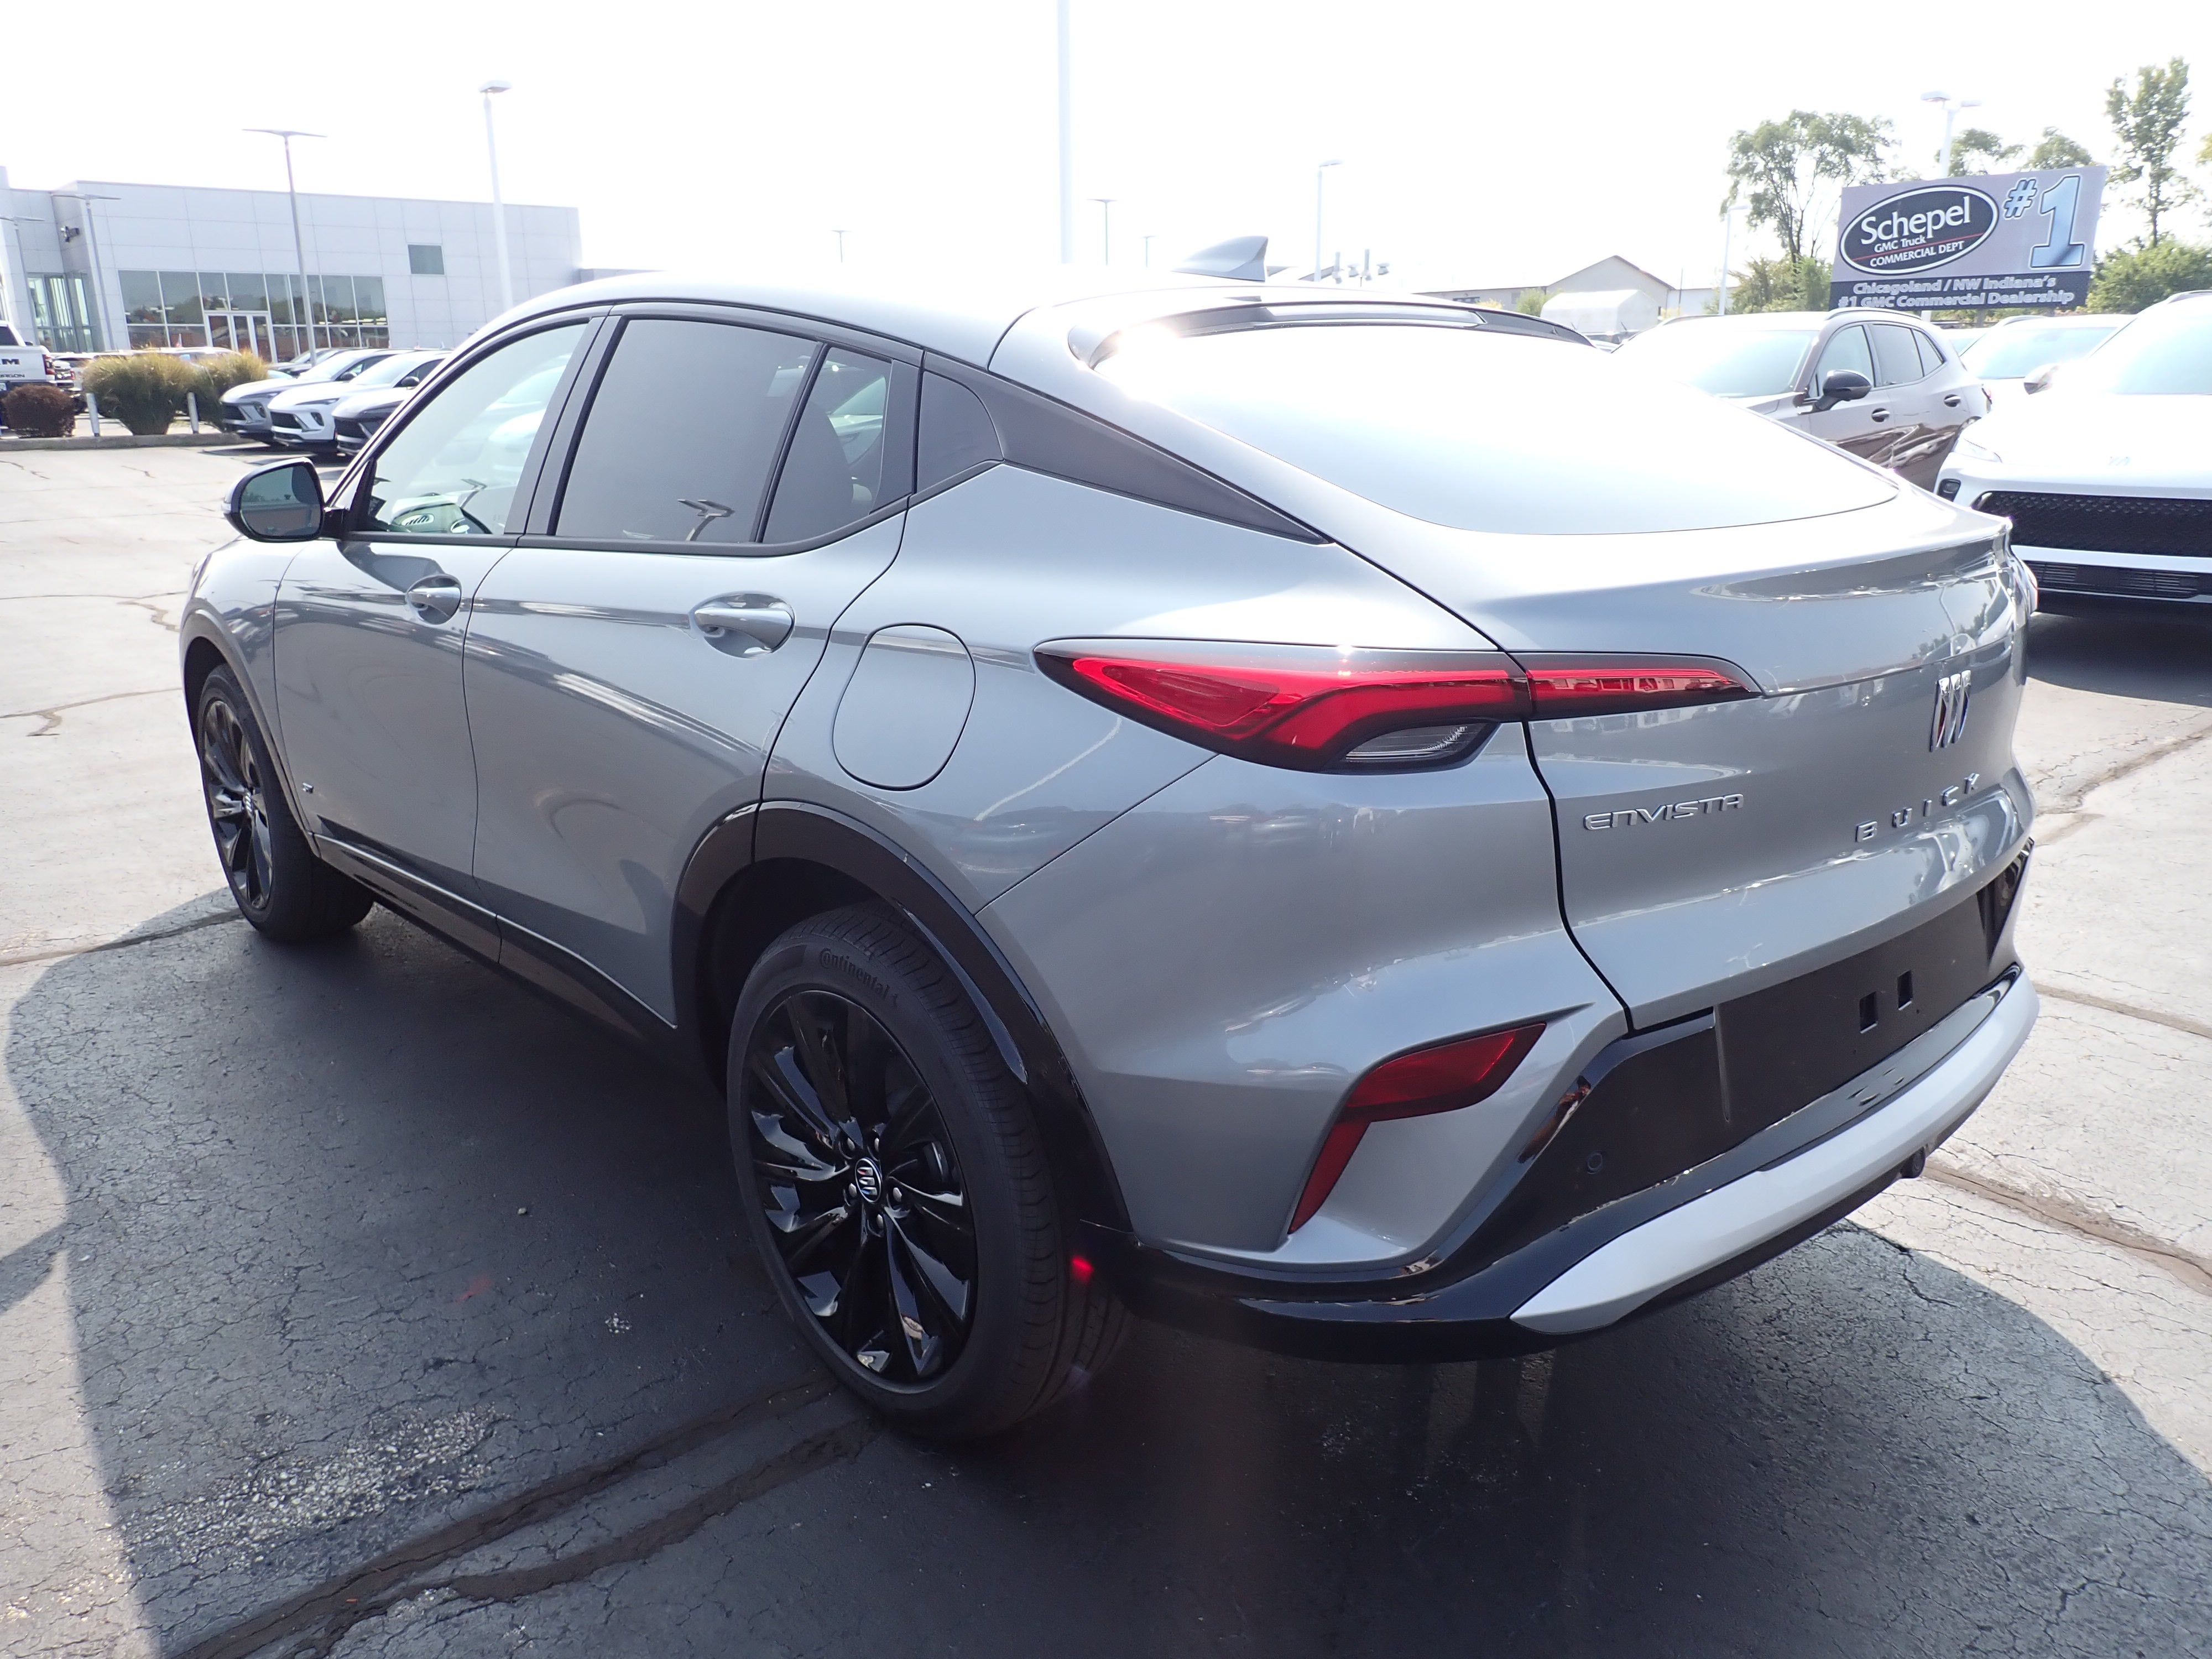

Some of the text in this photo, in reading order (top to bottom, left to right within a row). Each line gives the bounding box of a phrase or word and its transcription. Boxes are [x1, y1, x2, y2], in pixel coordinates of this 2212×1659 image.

[1860, 195, 1971, 244] Schepel
[2003, 174, 2085, 270] #1
[1870, 241, 1965, 268] COMMERCIAL DEPT
[1874, 235, 1927, 253] GMC Truck
[1838, 289, 2075, 308] #1 GMC Commercial Dealership
[1853, 279, 1942, 296] Chicagoland
[1953, 278, 1982, 291] NW
[1983, 275, 2057, 290] Indiana's
[1583, 793, 1745, 831] ENVISTA
[1855, 773, 1980, 842] BUICK
[819, 947, 890, 999] Continental
